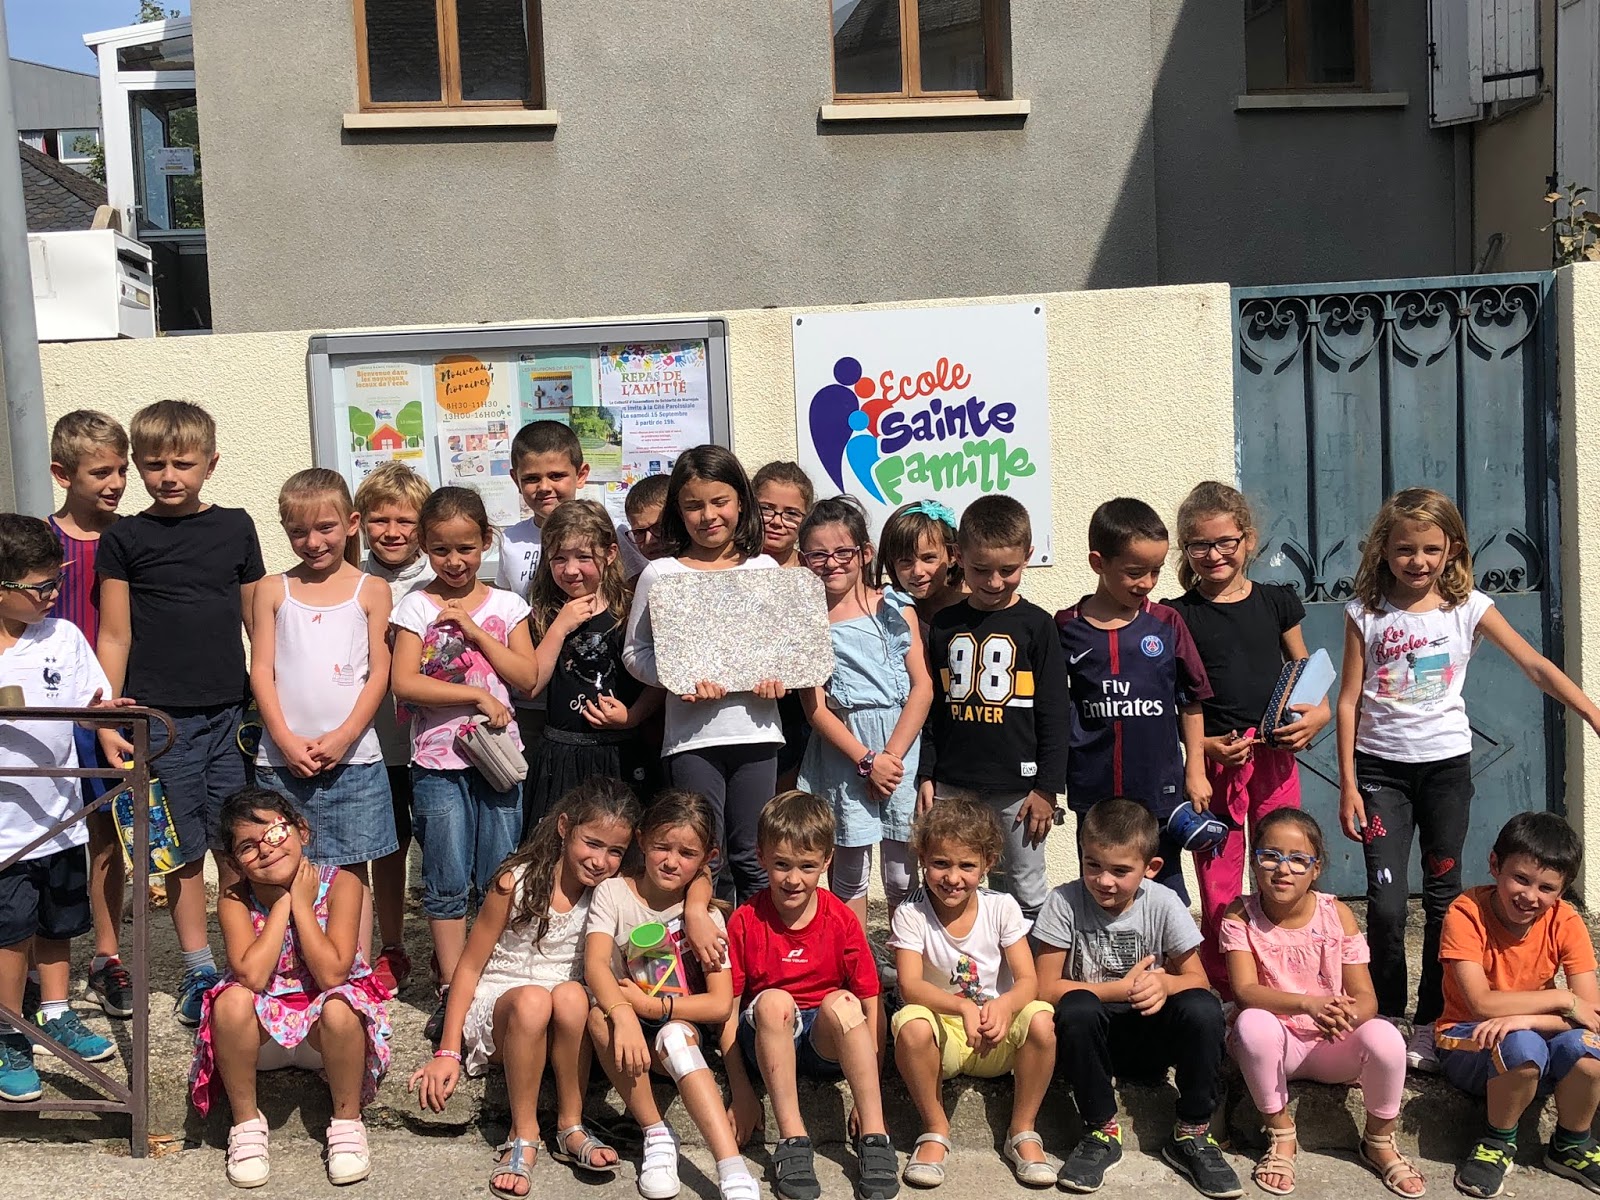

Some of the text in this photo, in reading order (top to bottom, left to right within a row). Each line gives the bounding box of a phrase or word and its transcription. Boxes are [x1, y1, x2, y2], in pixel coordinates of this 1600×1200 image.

[441, 362, 493, 382] Nouveaux
[621, 371, 681, 382] REPAS DE
[446, 401, 498, 410] 8H30-11H30
[444, 411, 501, 420] 13H00-16H00
[640, 419, 655, 427] partir
[1382, 626, 1405, 643] Los
[1375, 634, 1429, 663] Angeles
[948, 632, 1017, 705] 98
[1102, 679, 1130, 697] Fly
[951, 704, 1004, 724] PLAYER
[1082, 697, 1164, 720] Emirates
[1092, 1130, 1109, 1143] FILA
